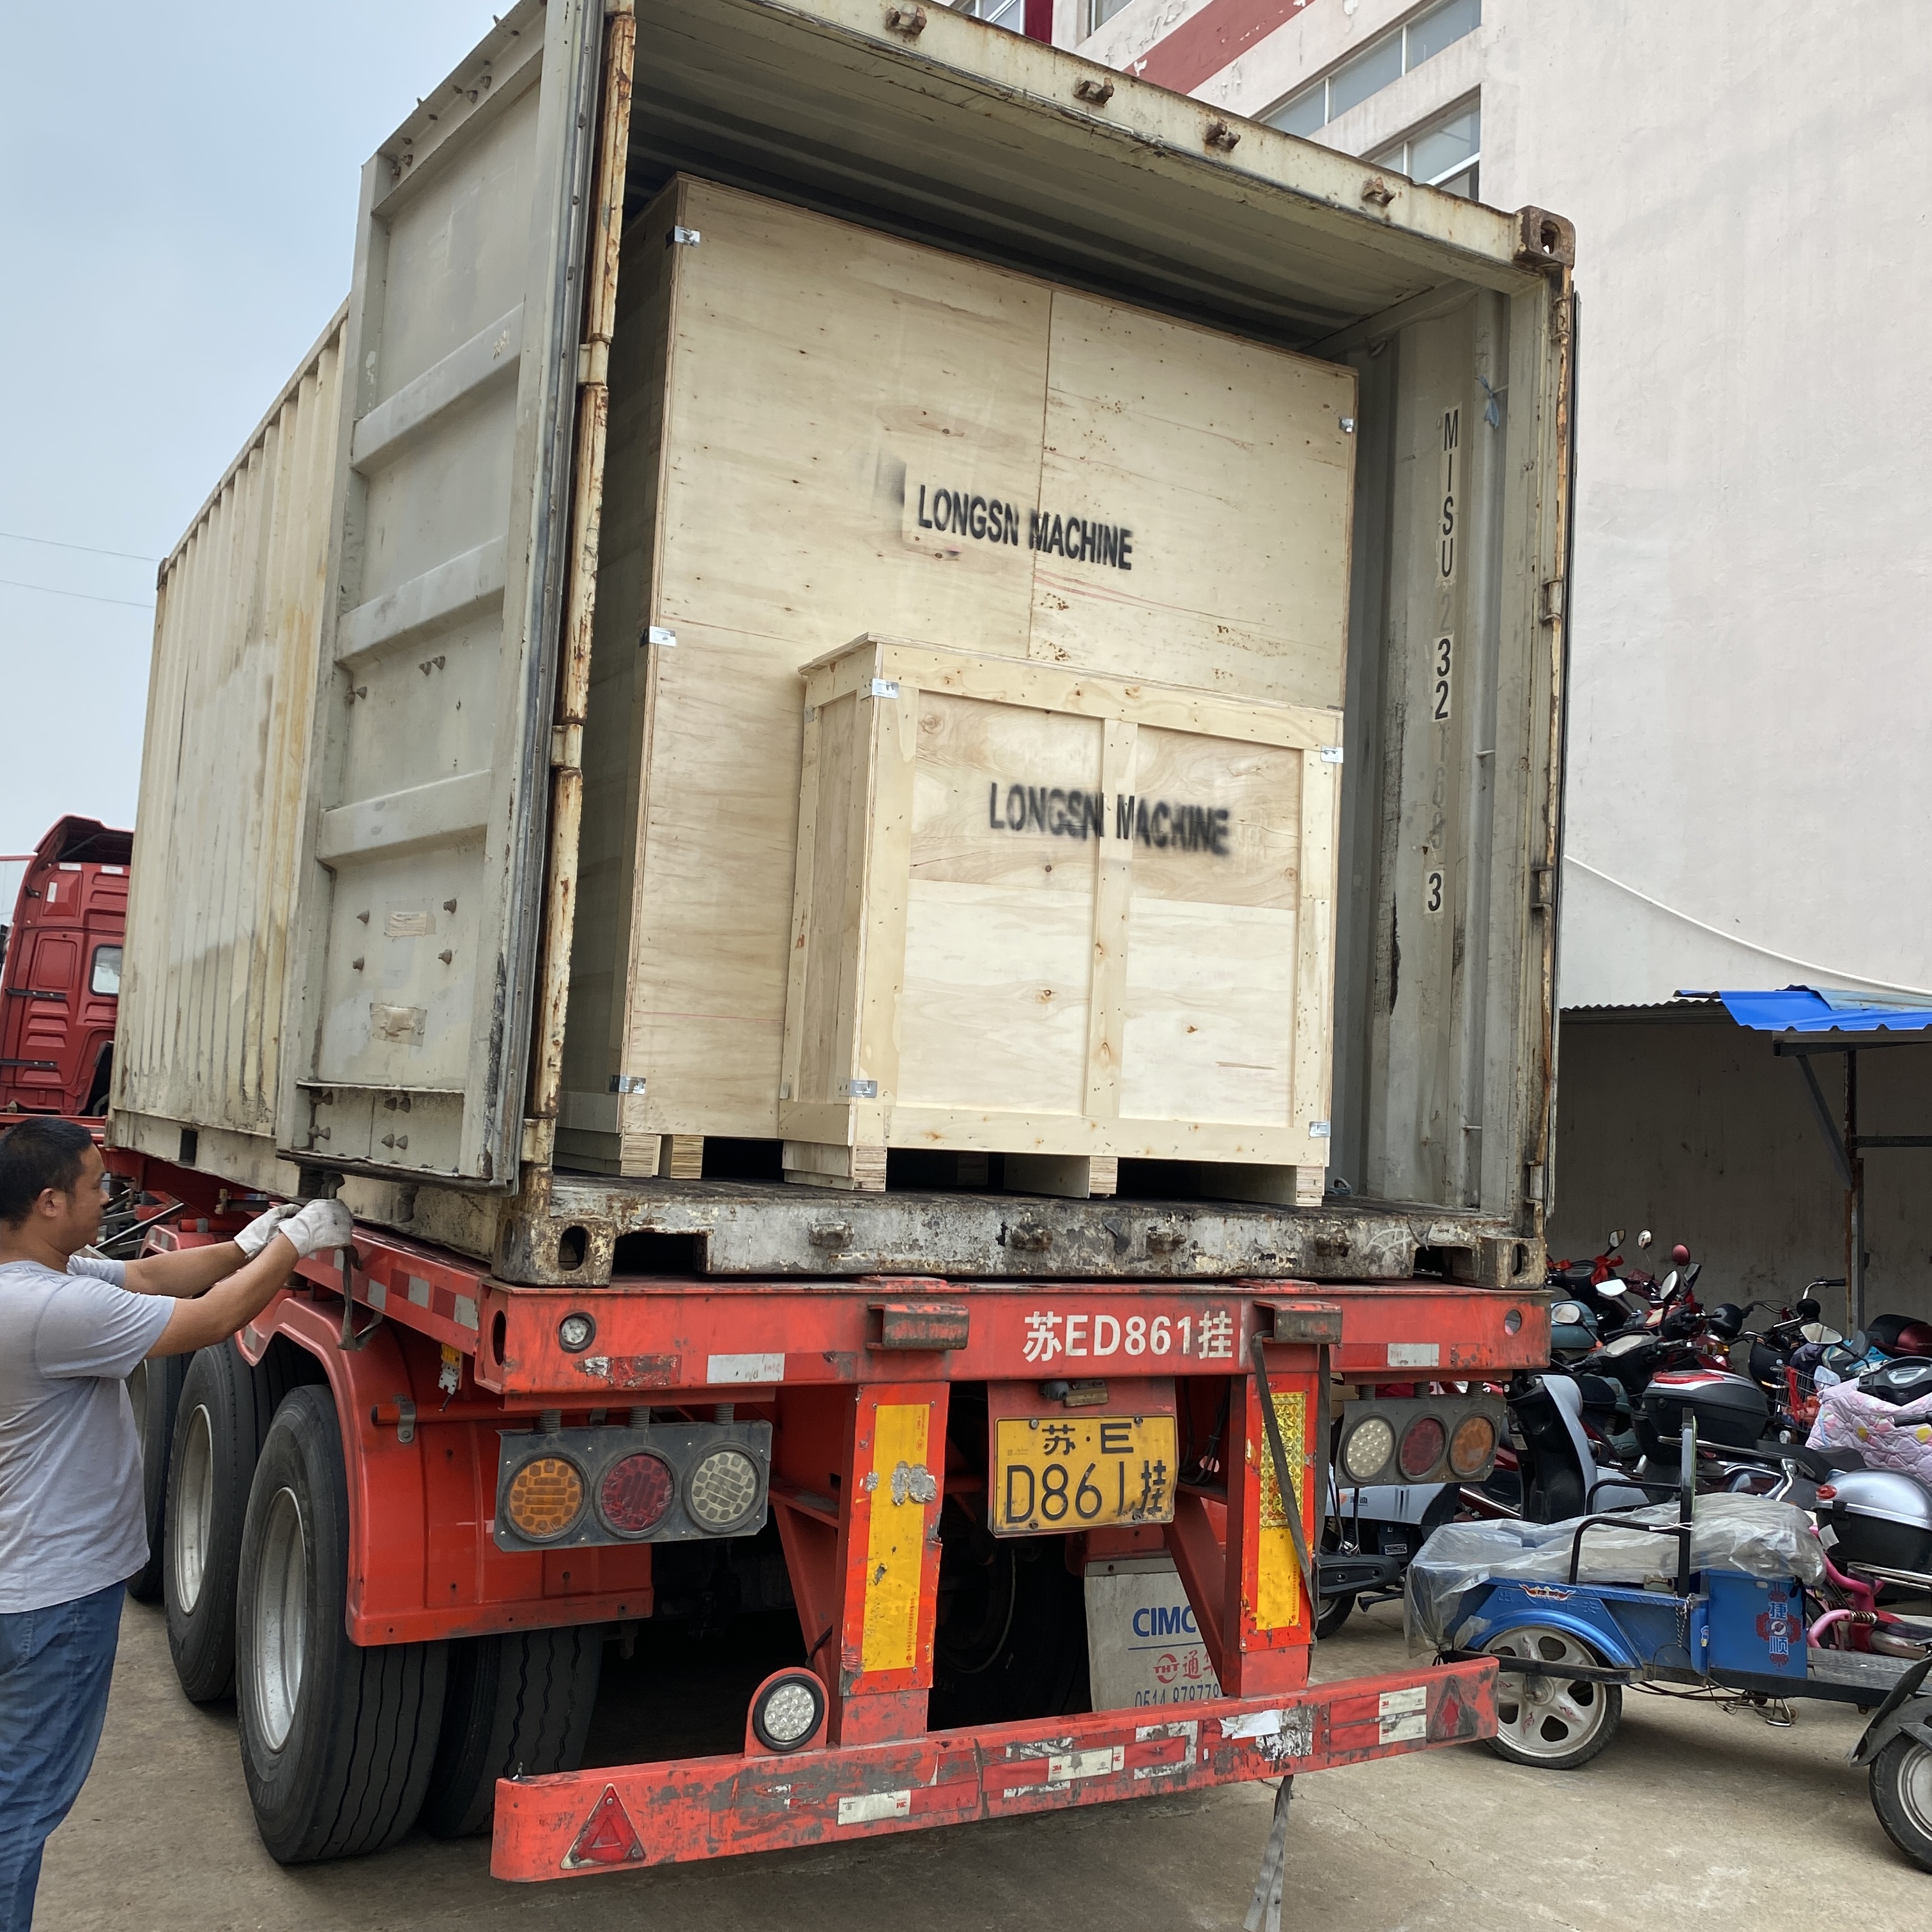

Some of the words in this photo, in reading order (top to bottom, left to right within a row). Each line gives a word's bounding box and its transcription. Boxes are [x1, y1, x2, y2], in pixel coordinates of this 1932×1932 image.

[1441, 409, 1459, 578] MISU
[918, 484, 1020, 546] LONGSN
[1028, 509, 1133, 570] MACHINE
[990, 782, 1104, 841] LONGSN
[1116, 793, 1230, 855] MACHINE
[1427, 873, 1442, 912] 3
[1022, 1310, 1234, 1363] 苏ED861挂
[1006, 1459, 1167, 1524] D861挂
[1132, 1605, 1197, 1637] CIMC
[1768, 1602, 1789, 1655] 捷顺
